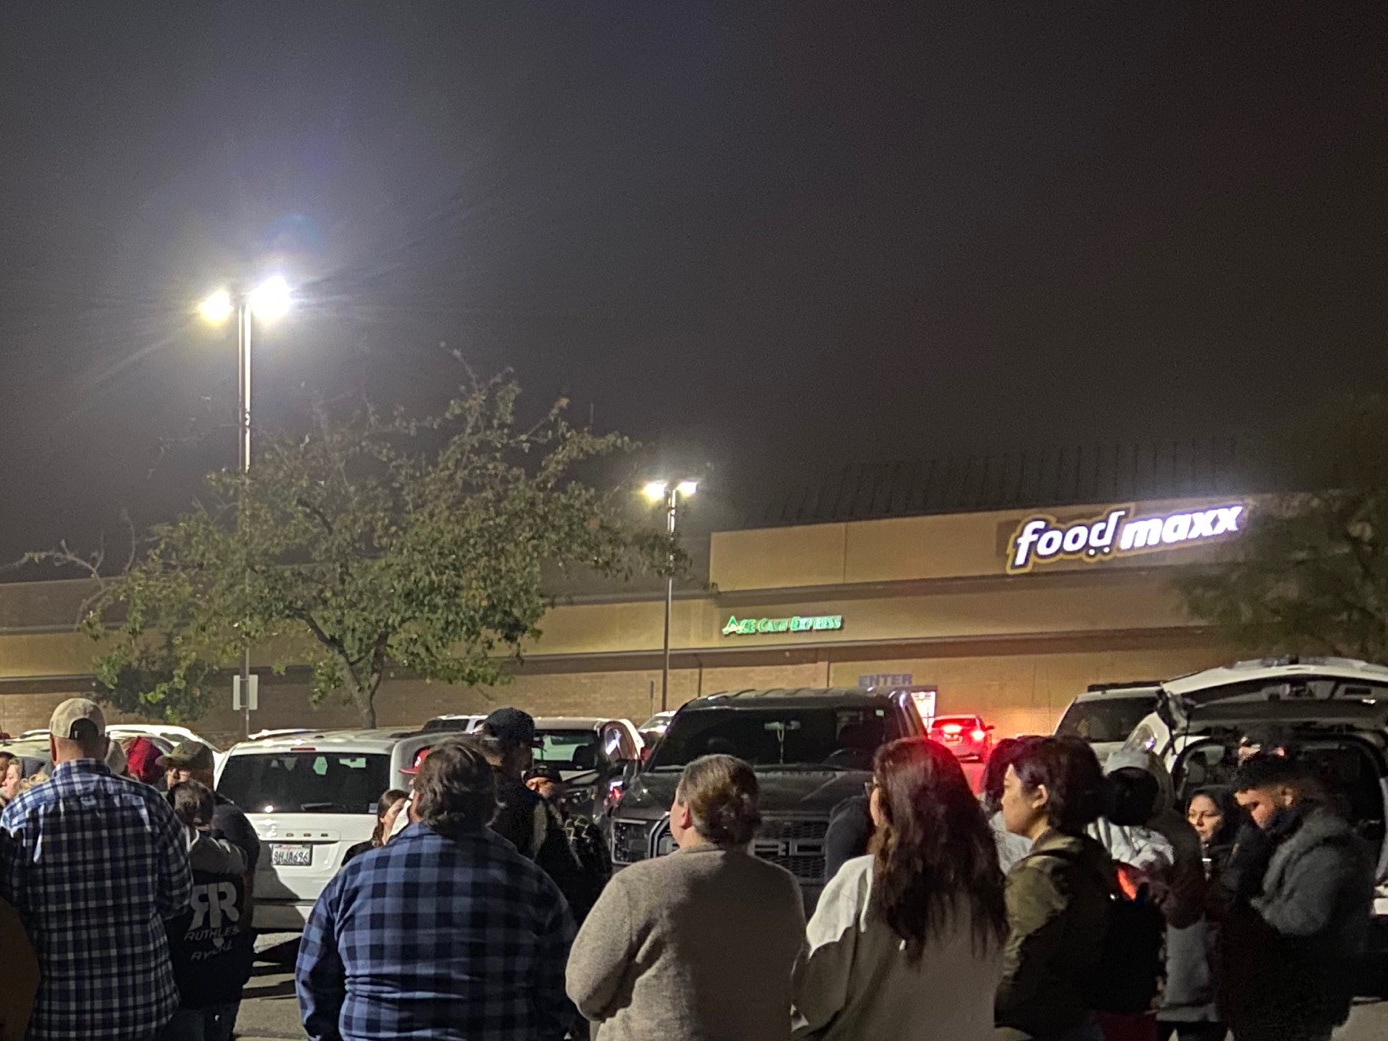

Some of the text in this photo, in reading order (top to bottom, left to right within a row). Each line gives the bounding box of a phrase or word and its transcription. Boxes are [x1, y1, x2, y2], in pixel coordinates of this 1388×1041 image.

[1014, 506, 1243, 566] food maxx
[858, 674, 913, 687] ENTER
